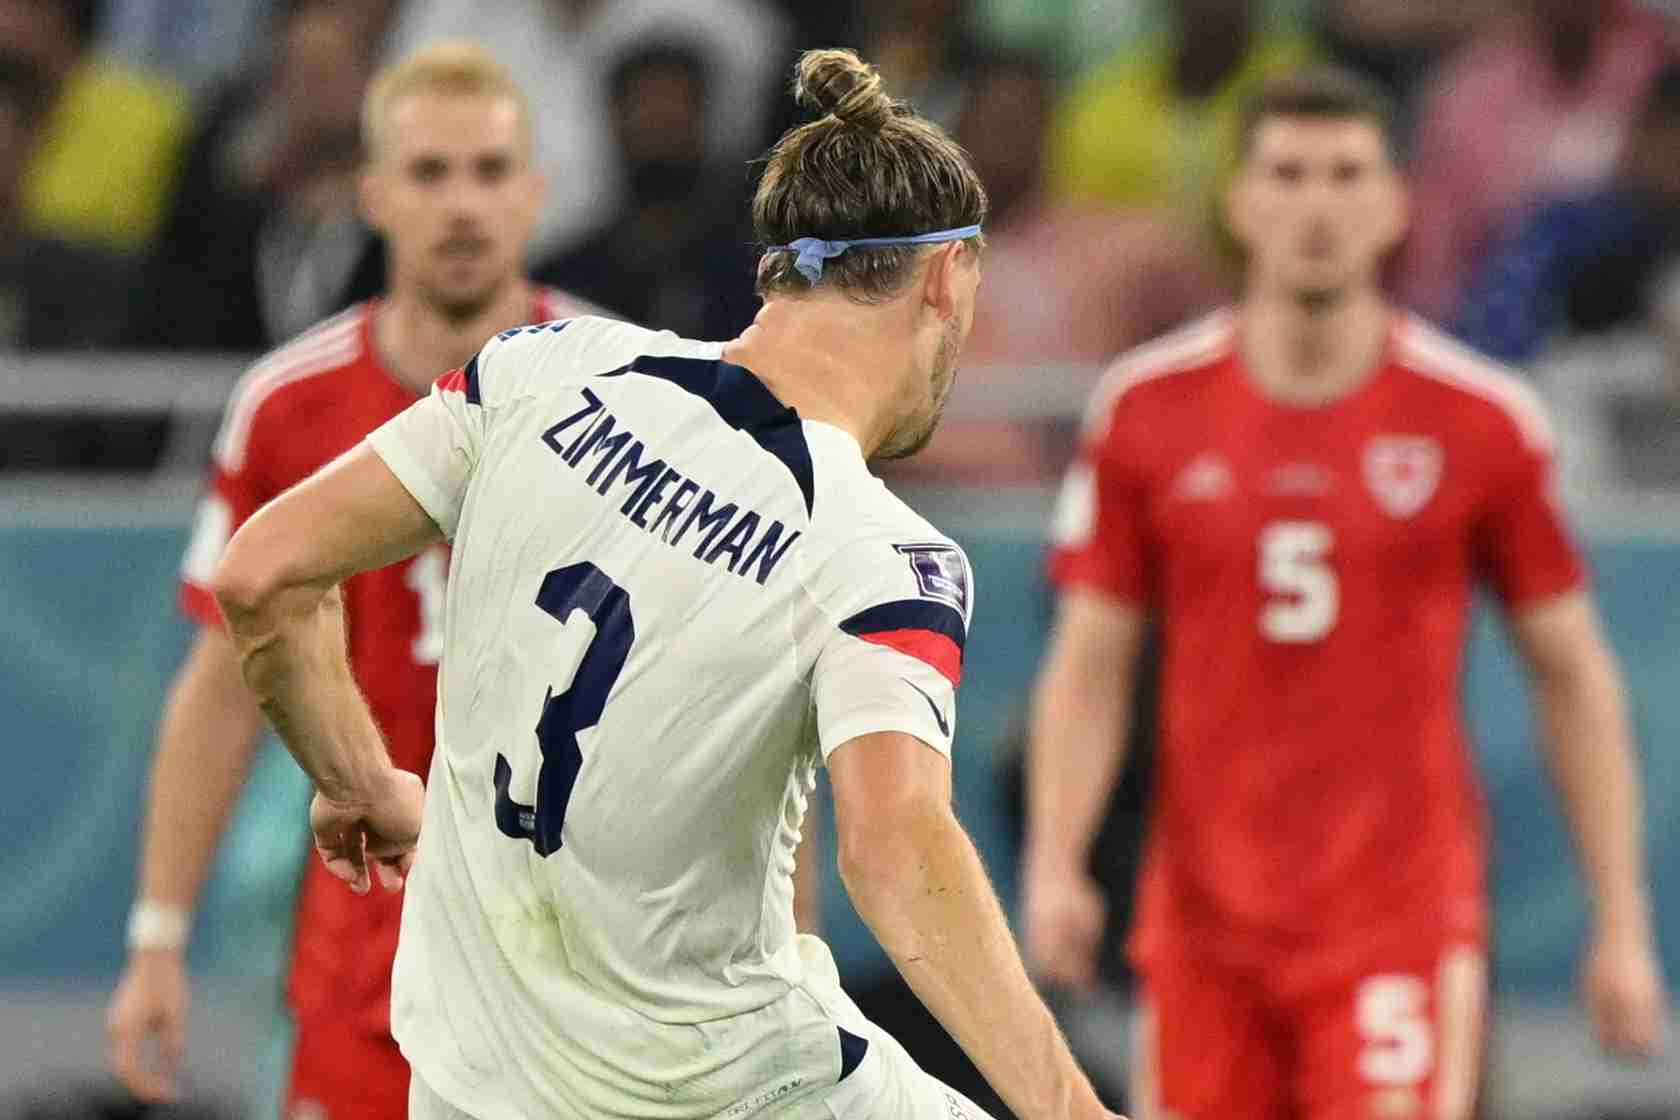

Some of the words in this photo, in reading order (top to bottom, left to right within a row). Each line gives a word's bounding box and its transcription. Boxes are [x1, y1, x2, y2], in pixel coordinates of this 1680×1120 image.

[539, 386, 803, 585] ZIMMERMAN
[1257, 520, 1341, 643] 5
[494, 560, 636, 858] 3
[1354, 972, 1434, 1087] 5
